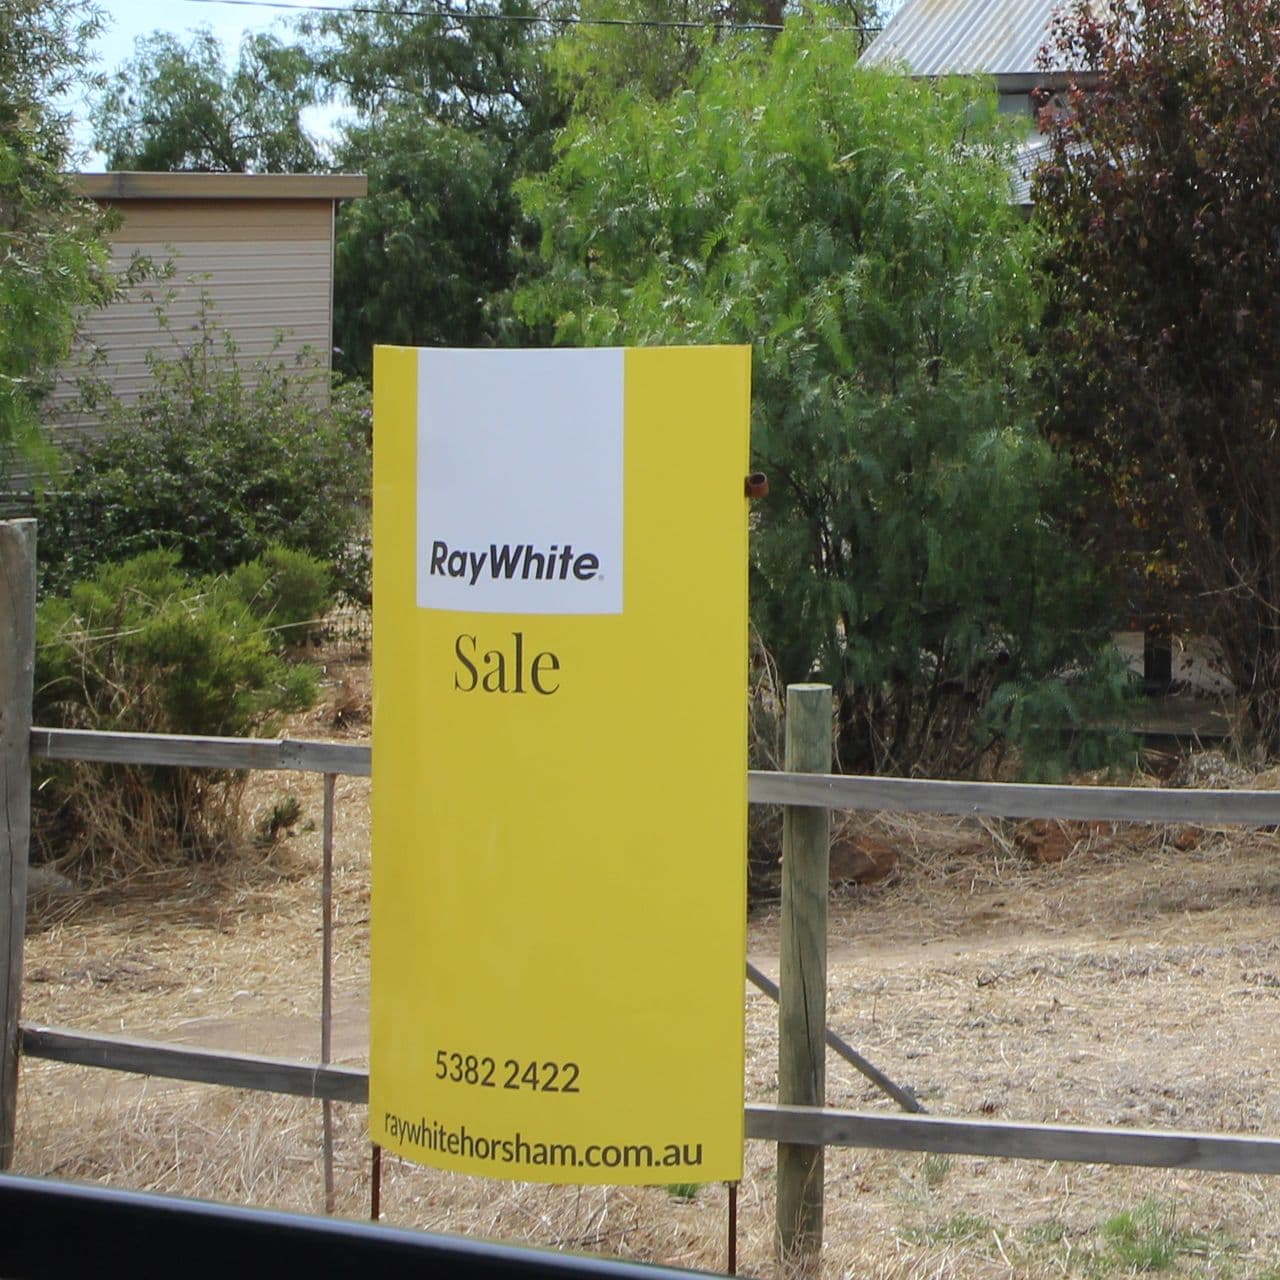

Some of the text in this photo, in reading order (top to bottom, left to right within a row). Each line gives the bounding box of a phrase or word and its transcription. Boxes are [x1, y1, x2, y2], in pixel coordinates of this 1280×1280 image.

[455, 632, 560, 695] Sale
[436, 1050, 580, 1093] 5382 2422
[384, 1111, 703, 1168] raywhitehorsham.com.au
